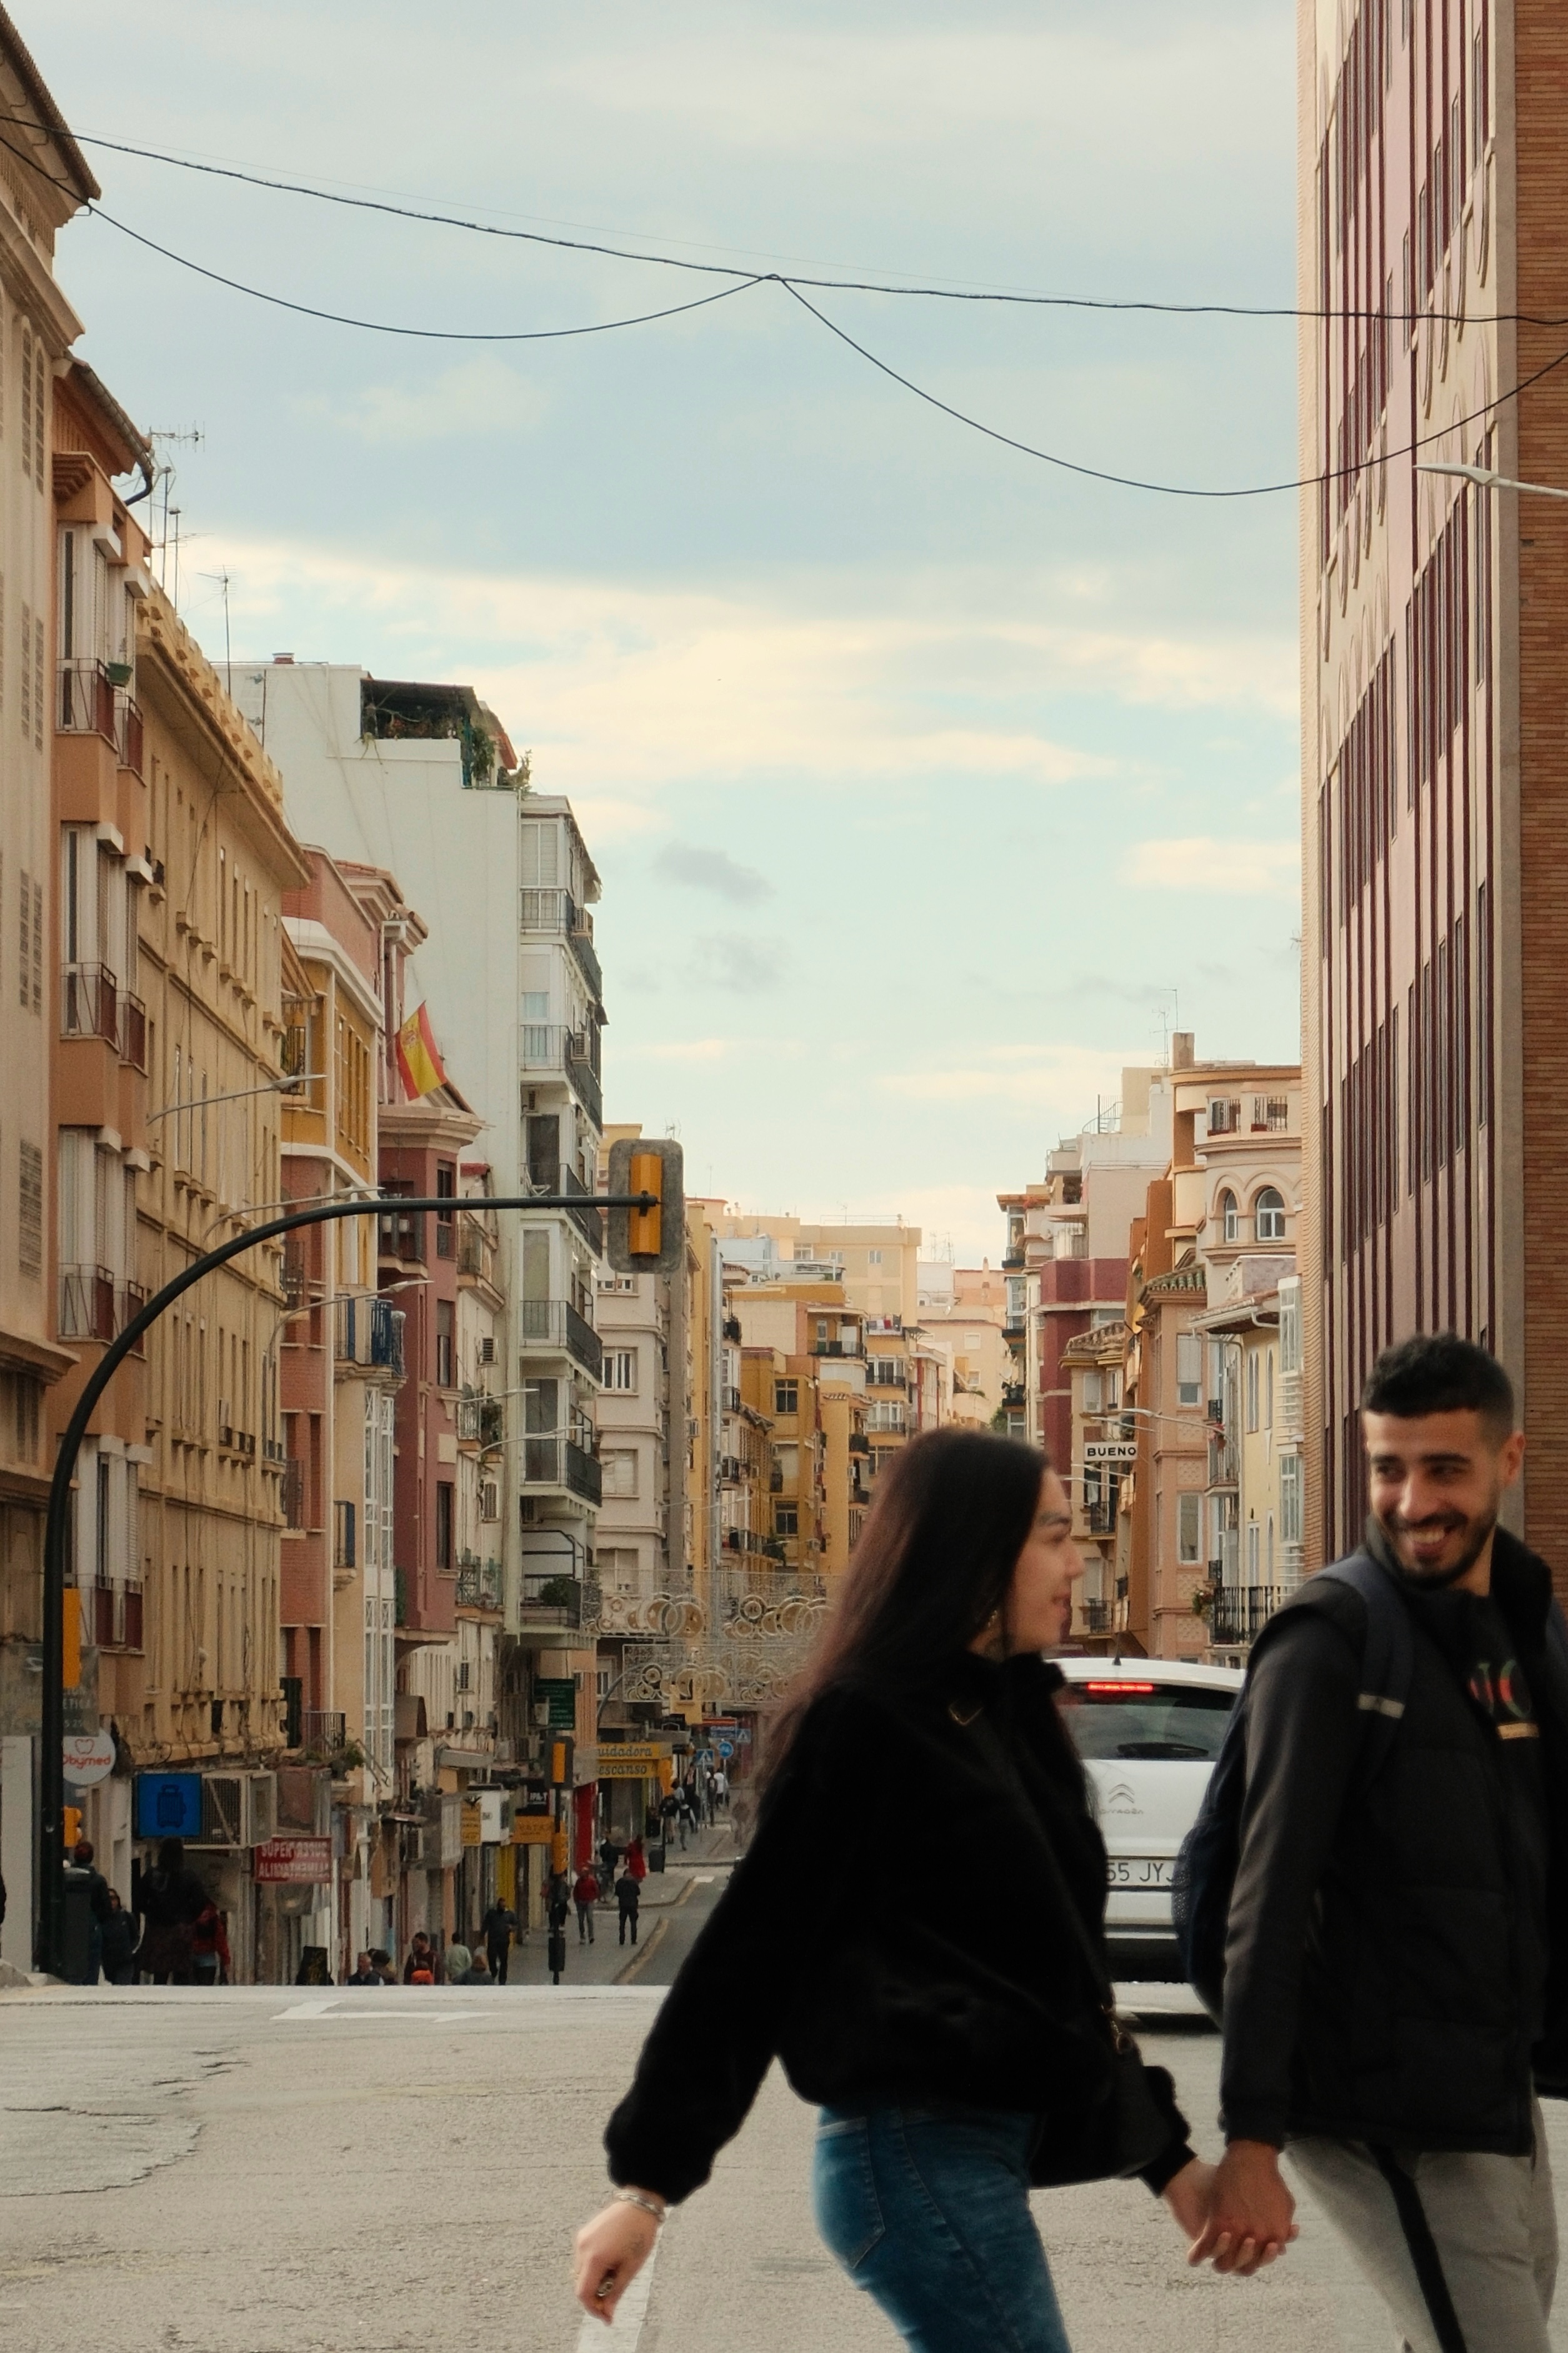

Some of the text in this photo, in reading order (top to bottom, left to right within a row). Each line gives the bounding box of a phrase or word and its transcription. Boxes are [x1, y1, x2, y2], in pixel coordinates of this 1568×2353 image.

[1087, 1447, 1136, 1457] BUENO
[598, 1745, 652, 1757] uidadora
[599, 1765, 647, 1775] escanso
[1107, 1862, 1130, 1882] 55
